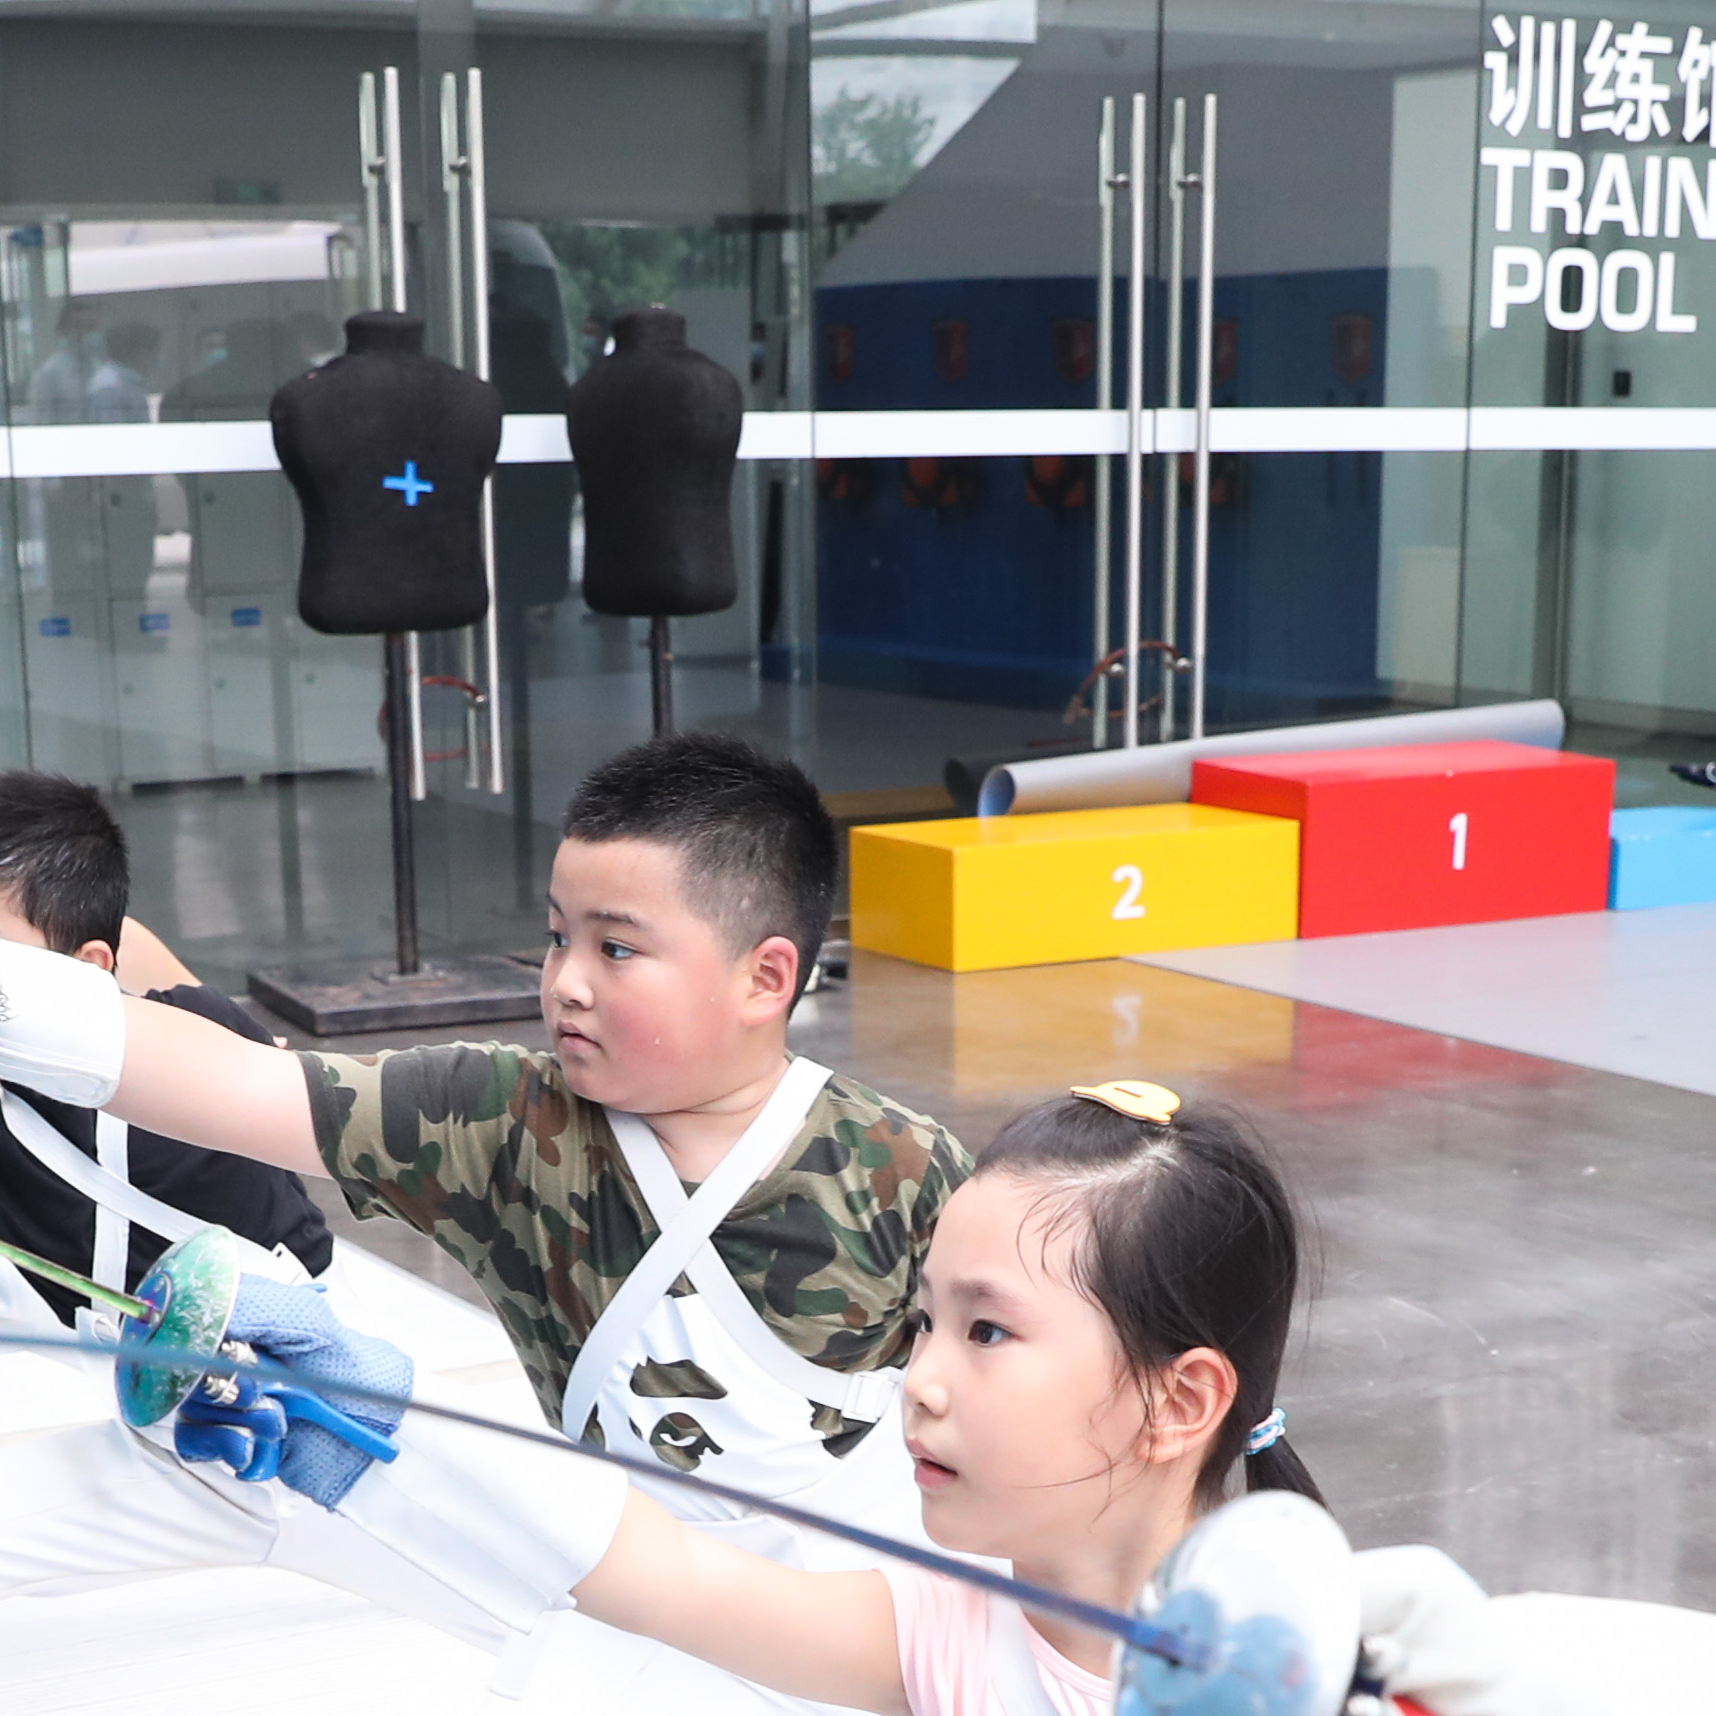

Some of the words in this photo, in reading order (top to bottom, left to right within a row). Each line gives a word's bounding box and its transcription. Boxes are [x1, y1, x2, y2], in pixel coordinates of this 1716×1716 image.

[1489, 246, 1697, 333] POOL
[1447, 812, 1469, 871] 1
[1111, 864, 1146, 921] 2
